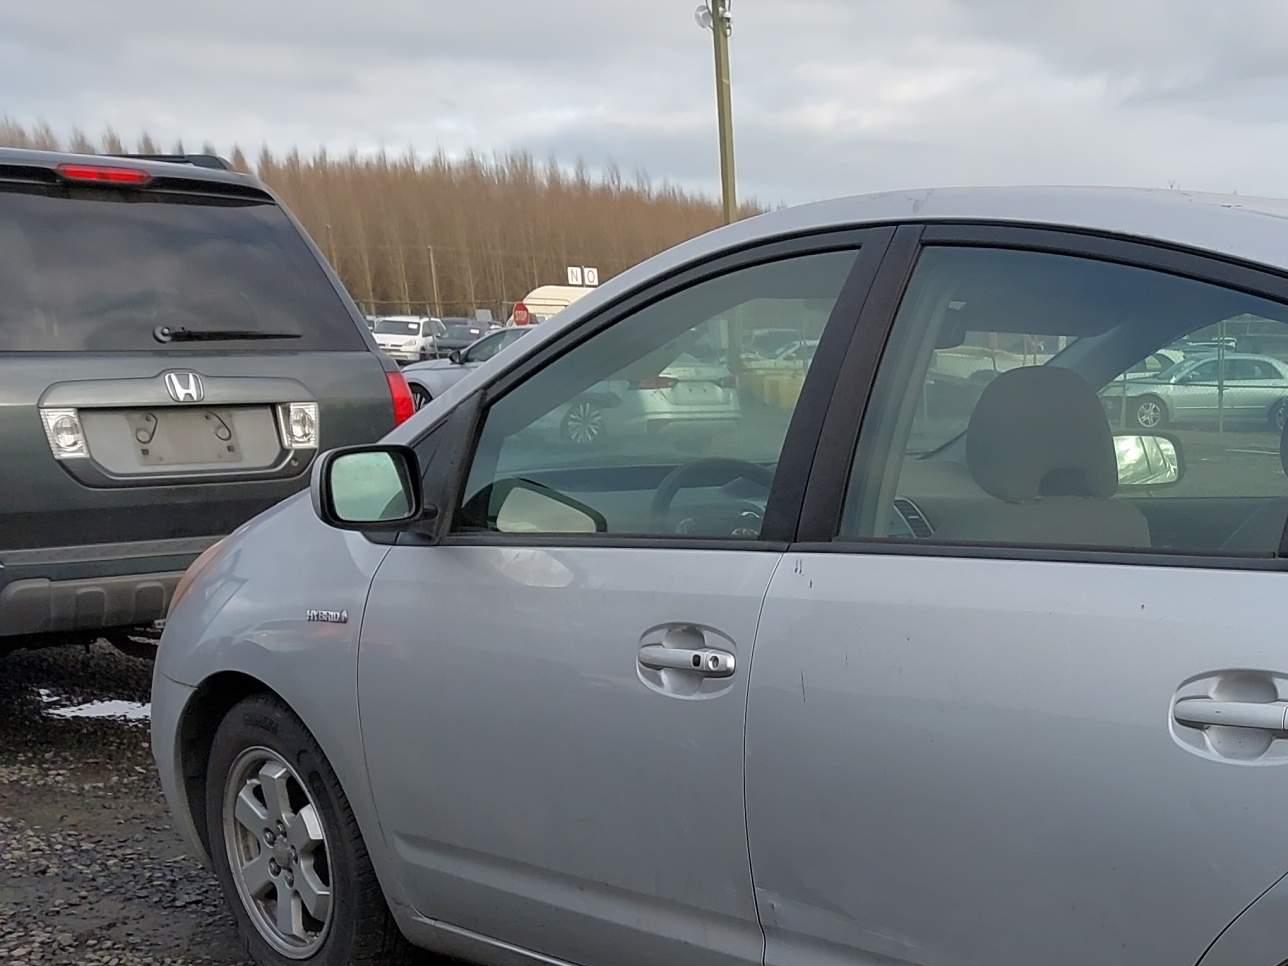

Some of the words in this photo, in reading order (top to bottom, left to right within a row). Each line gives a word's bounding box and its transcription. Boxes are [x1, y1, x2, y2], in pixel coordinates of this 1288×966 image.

[570, 269, 579, 282] N
[514, 310, 528, 321] STOP
[305, 609, 341, 622] HYBRID
